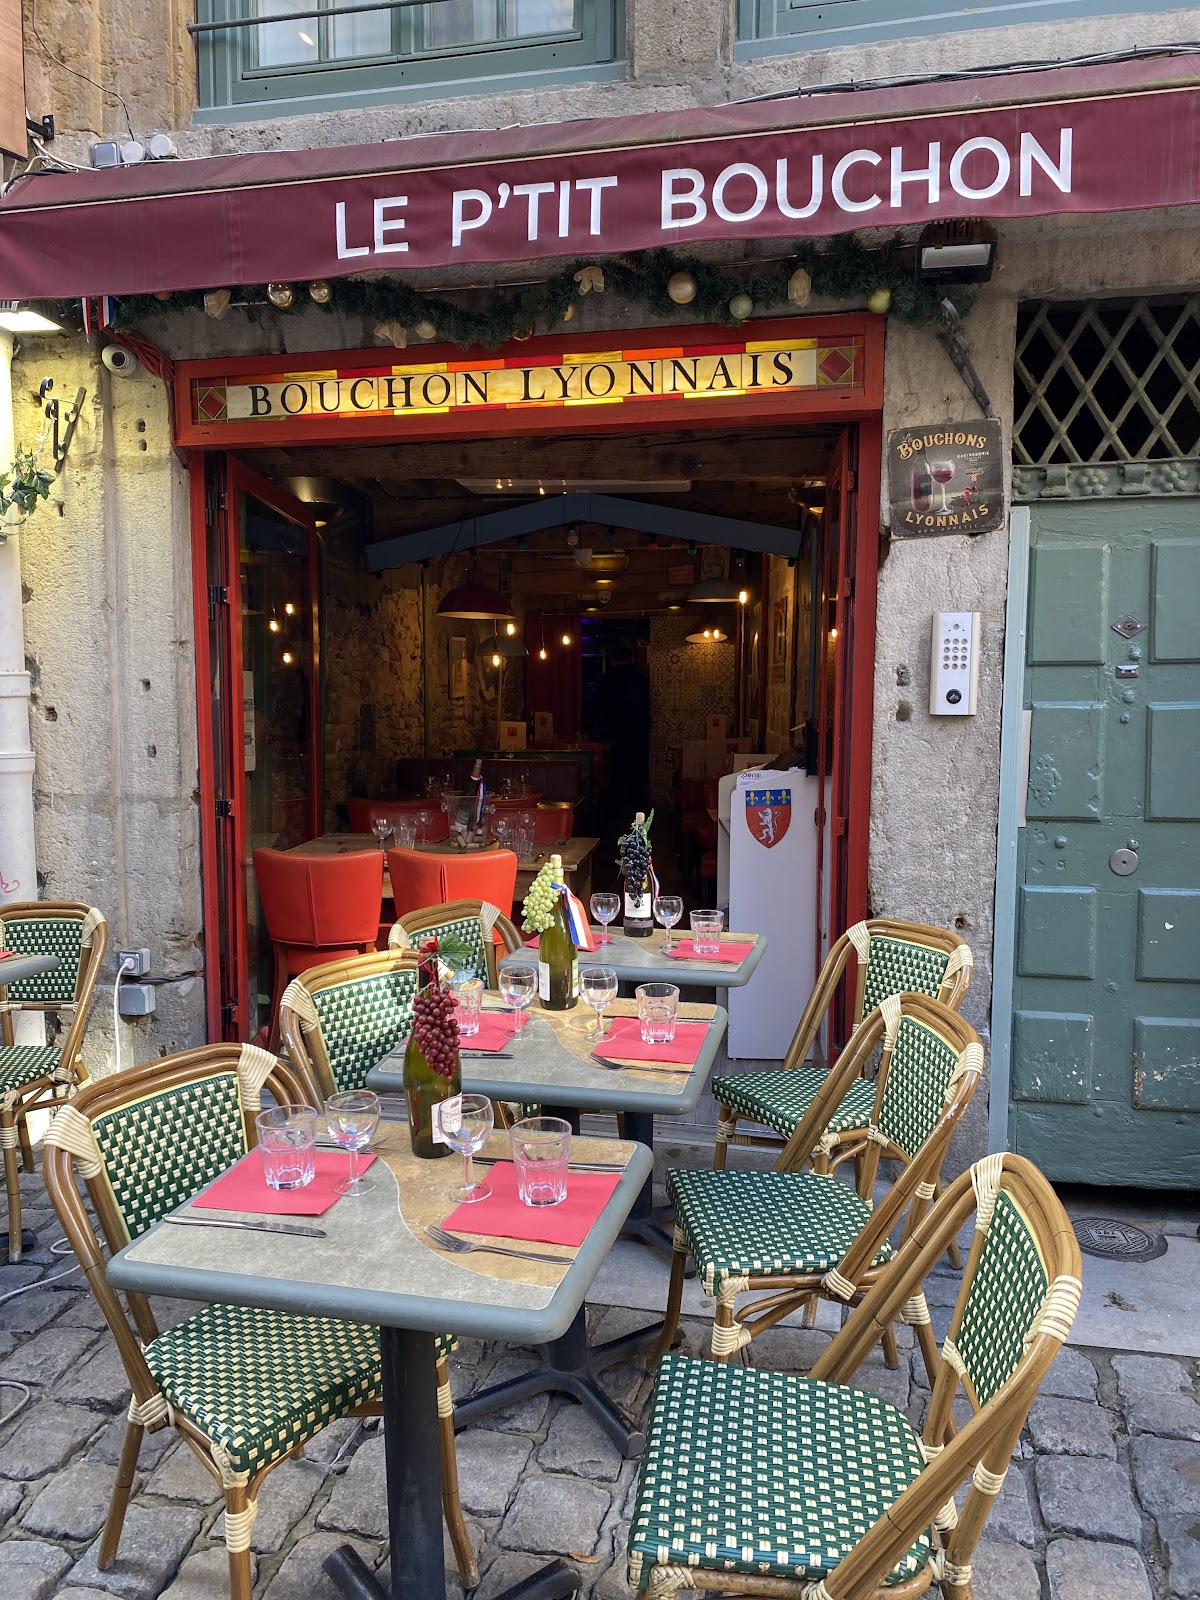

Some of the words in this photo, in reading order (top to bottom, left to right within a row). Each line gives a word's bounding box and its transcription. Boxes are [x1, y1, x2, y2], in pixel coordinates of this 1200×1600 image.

[334, 195, 409, 260] LE
[451, 175, 619, 247] P'TIT
[660, 127, 1074, 232] BOUCHON
[249, 370, 491, 417] BOUCHON
[521, 350, 795, 402] LYONNAIS
[896, 432, 987, 459] BOUCHONS
[905, 503, 989, 527] LYONNAIS
